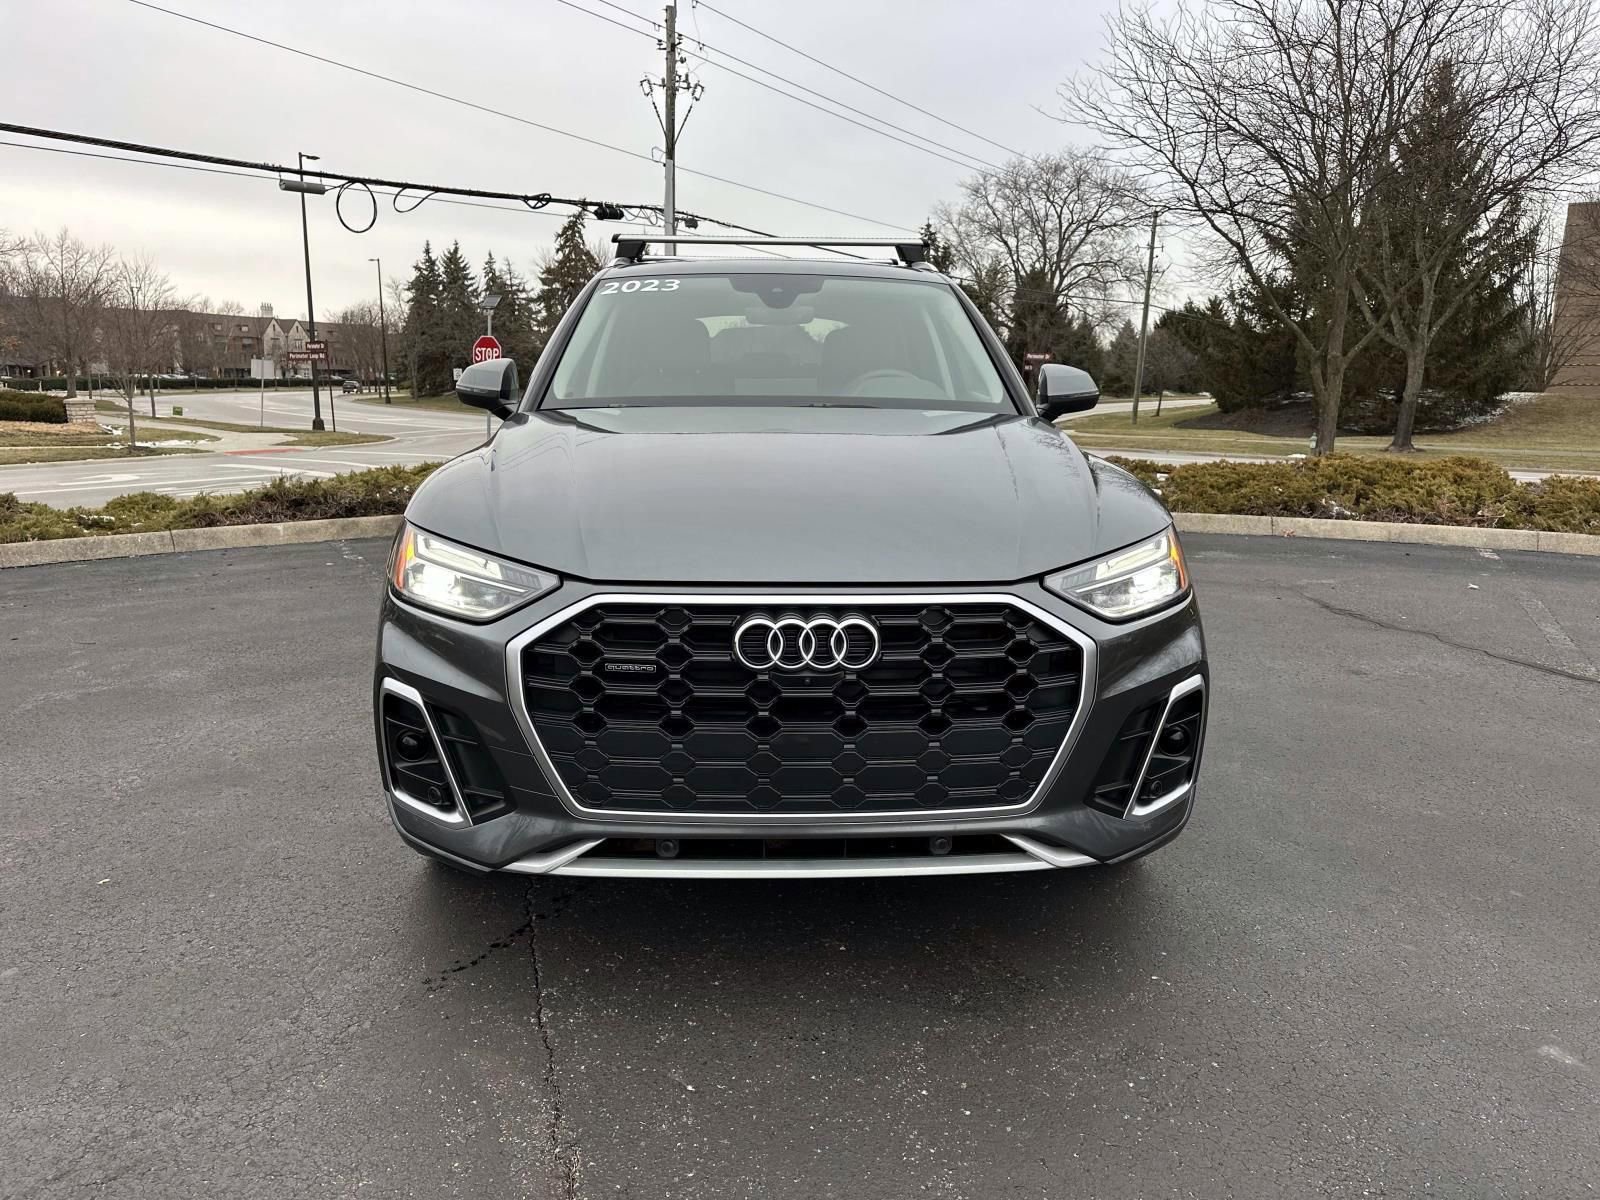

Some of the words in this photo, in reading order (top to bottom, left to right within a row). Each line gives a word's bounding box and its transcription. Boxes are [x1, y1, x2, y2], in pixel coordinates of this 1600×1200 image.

[600, 279, 680, 295] 2023
[475, 347, 500, 361] STOP
[606, 664, 655, 672] quattro
